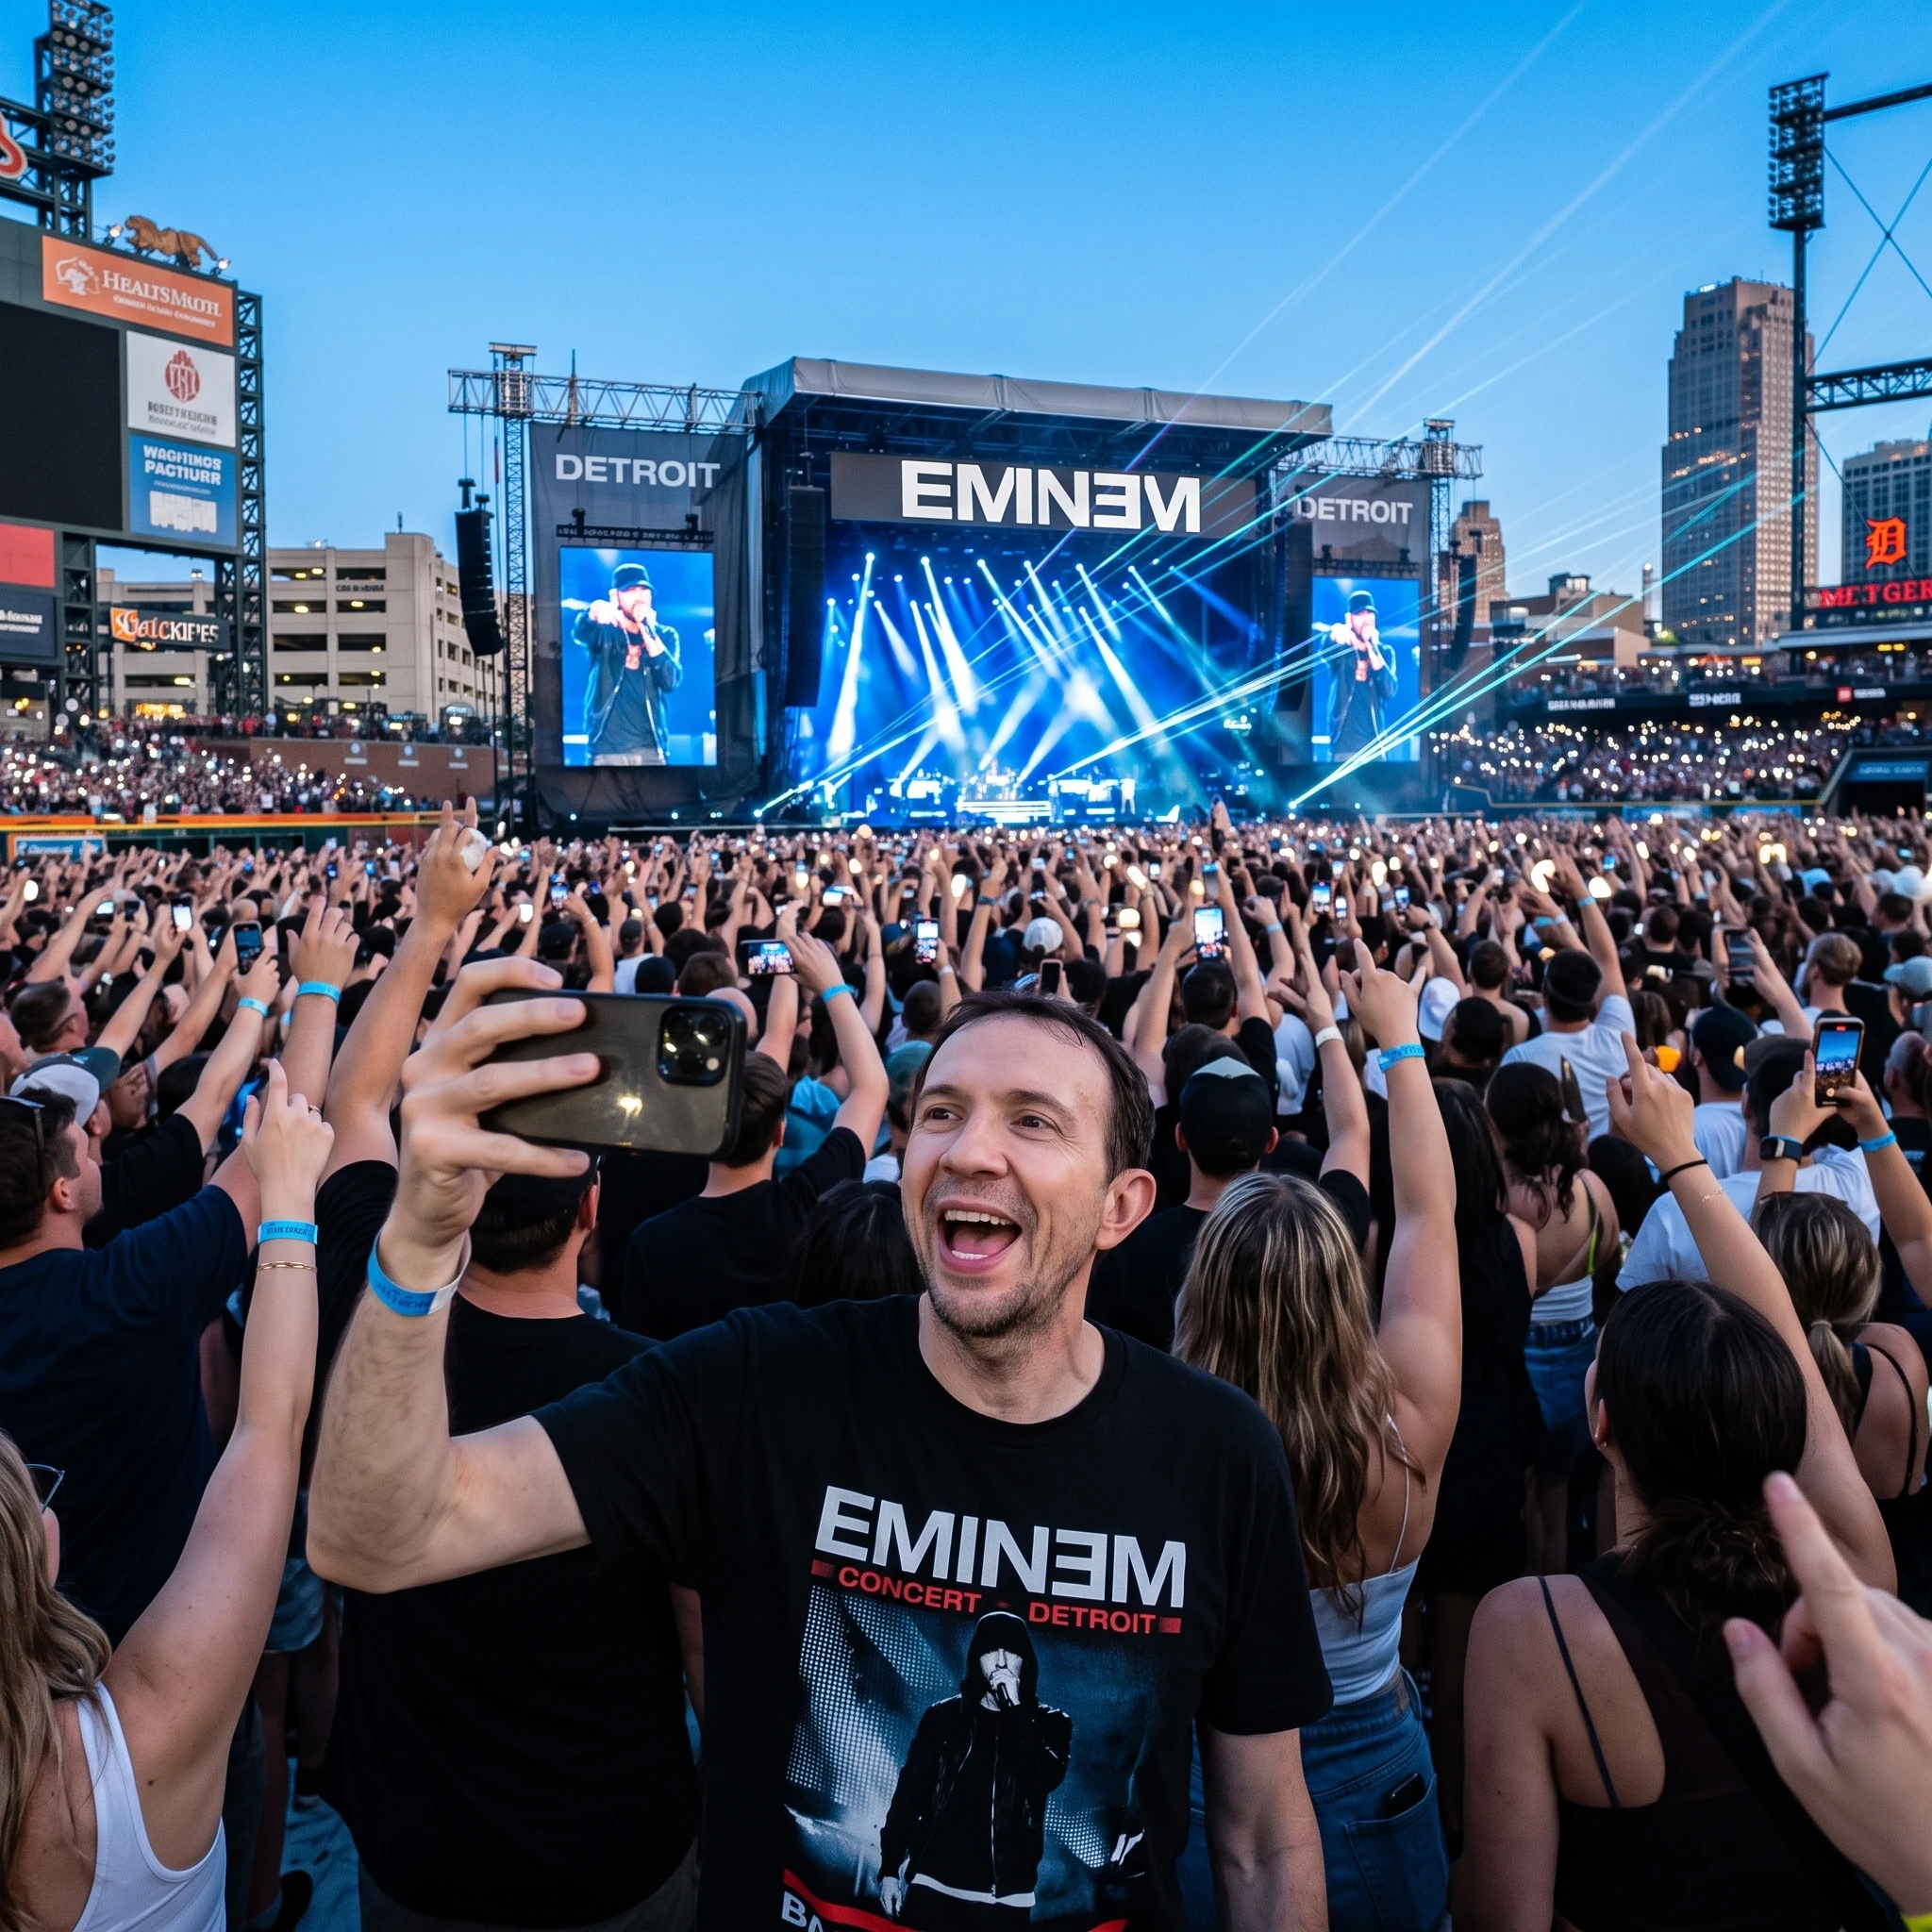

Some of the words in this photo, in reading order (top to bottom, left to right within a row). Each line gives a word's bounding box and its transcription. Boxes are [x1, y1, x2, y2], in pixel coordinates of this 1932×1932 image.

[555, 454, 721, 489] DETROIT
[901, 459, 1201, 533] EMINEM
[1296, 496, 1413, 525] DETROIT
[1865, 516, 1907, 571] D
[815, 1485, 1187, 1608] EMINEM
[838, 1566, 982, 1614] CONCERT
[1028, 1602, 1157, 1635] DETROIT
